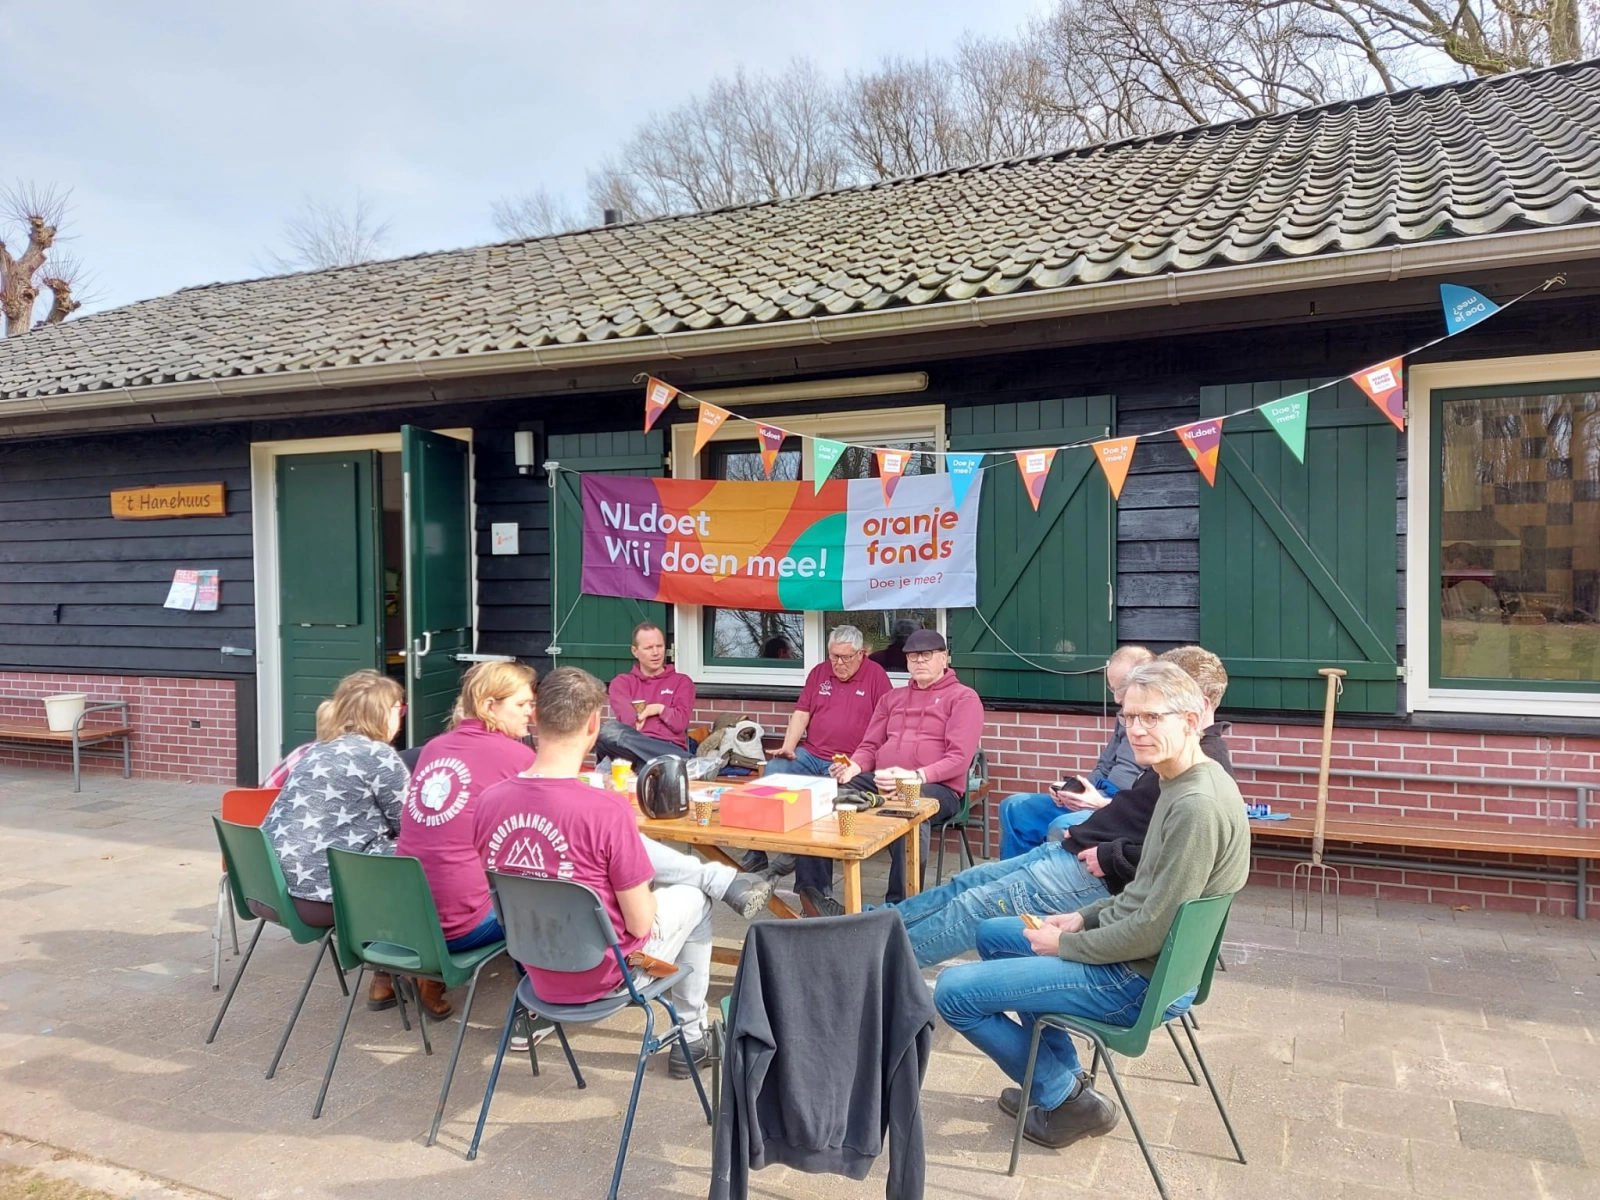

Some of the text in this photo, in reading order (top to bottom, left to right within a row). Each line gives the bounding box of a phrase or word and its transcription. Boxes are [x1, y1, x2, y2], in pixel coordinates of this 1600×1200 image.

[1271, 403, 1301, 416] Doe je
[1276, 411, 1301, 424] mee?
[759, 428, 782, 442] NLdoet
[1183, 426, 1217, 440] NLdoet
[818, 444, 831, 453] Doe
[1102, 445, 1128, 455] Doe je
[953, 459, 975, 470] Doe je
[1105, 453, 1127, 463] mee?
[953, 467, 973, 475] mee?
[140, 490, 211, 510] Hanehuus
[600, 501, 711, 536] NLdoet
[862, 506, 959, 540] oranje
[604, 536, 828, 578] Wij doen mee!
[866, 539, 954, 566] fonds
[869, 572, 943, 590] Doe je mee?
[488, 813, 569, 852] ROOTHAANGROEP
